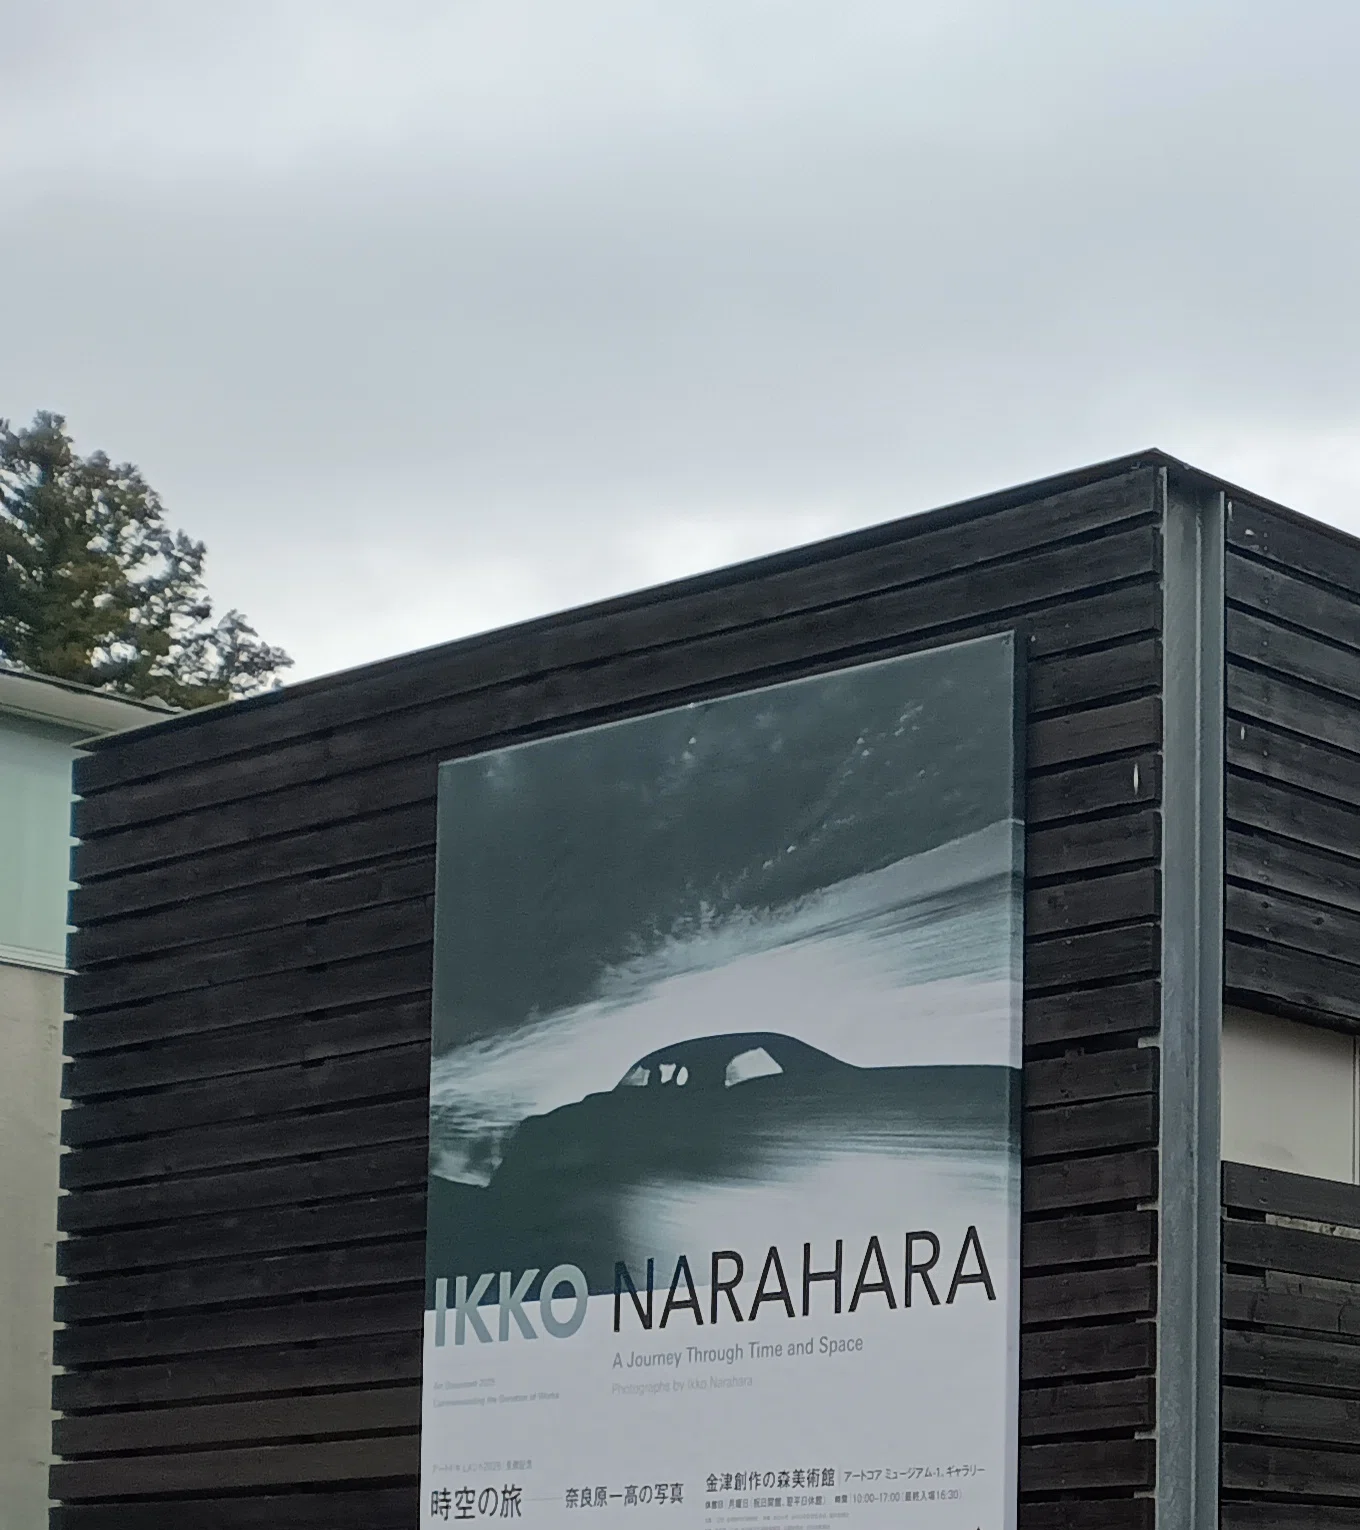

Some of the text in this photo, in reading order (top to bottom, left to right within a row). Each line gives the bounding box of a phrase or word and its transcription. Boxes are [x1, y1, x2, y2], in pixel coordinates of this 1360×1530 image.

[434, 1225, 997, 1347] IKKO NARAHARA
[612, 1336, 864, 1369] A Journey Through Time and Space
[672, 1379, 685, 1393] by
[709, 1375, 753, 1388] Narahara
[705, 1467, 836, 1493] 金津創作の森美術館
[844, 1469, 883, 1482] アートコア
[430, 1482, 684, 1521] 時空の旅 奈良原一高の写真
